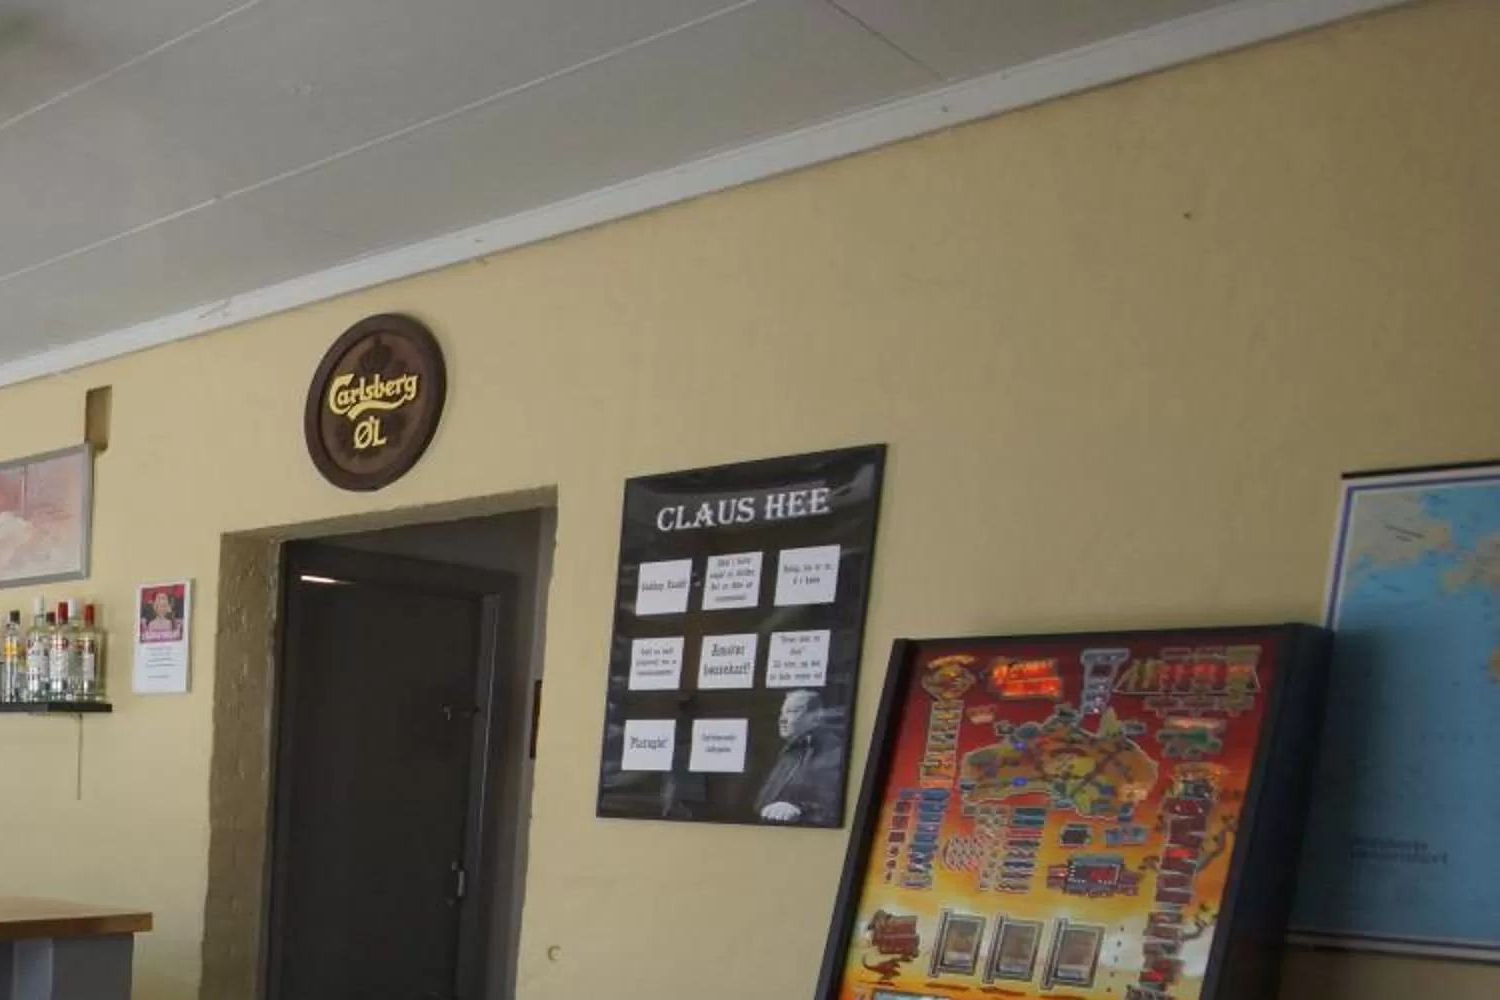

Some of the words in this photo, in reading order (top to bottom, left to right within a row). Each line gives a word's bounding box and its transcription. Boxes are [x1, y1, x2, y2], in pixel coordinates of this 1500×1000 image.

[329, 373, 419, 421] Carlsberg
[353, 415, 387, 449] ØL
[656, 498, 755, 531] CLAUS
[765, 488, 832, 520] HEE
